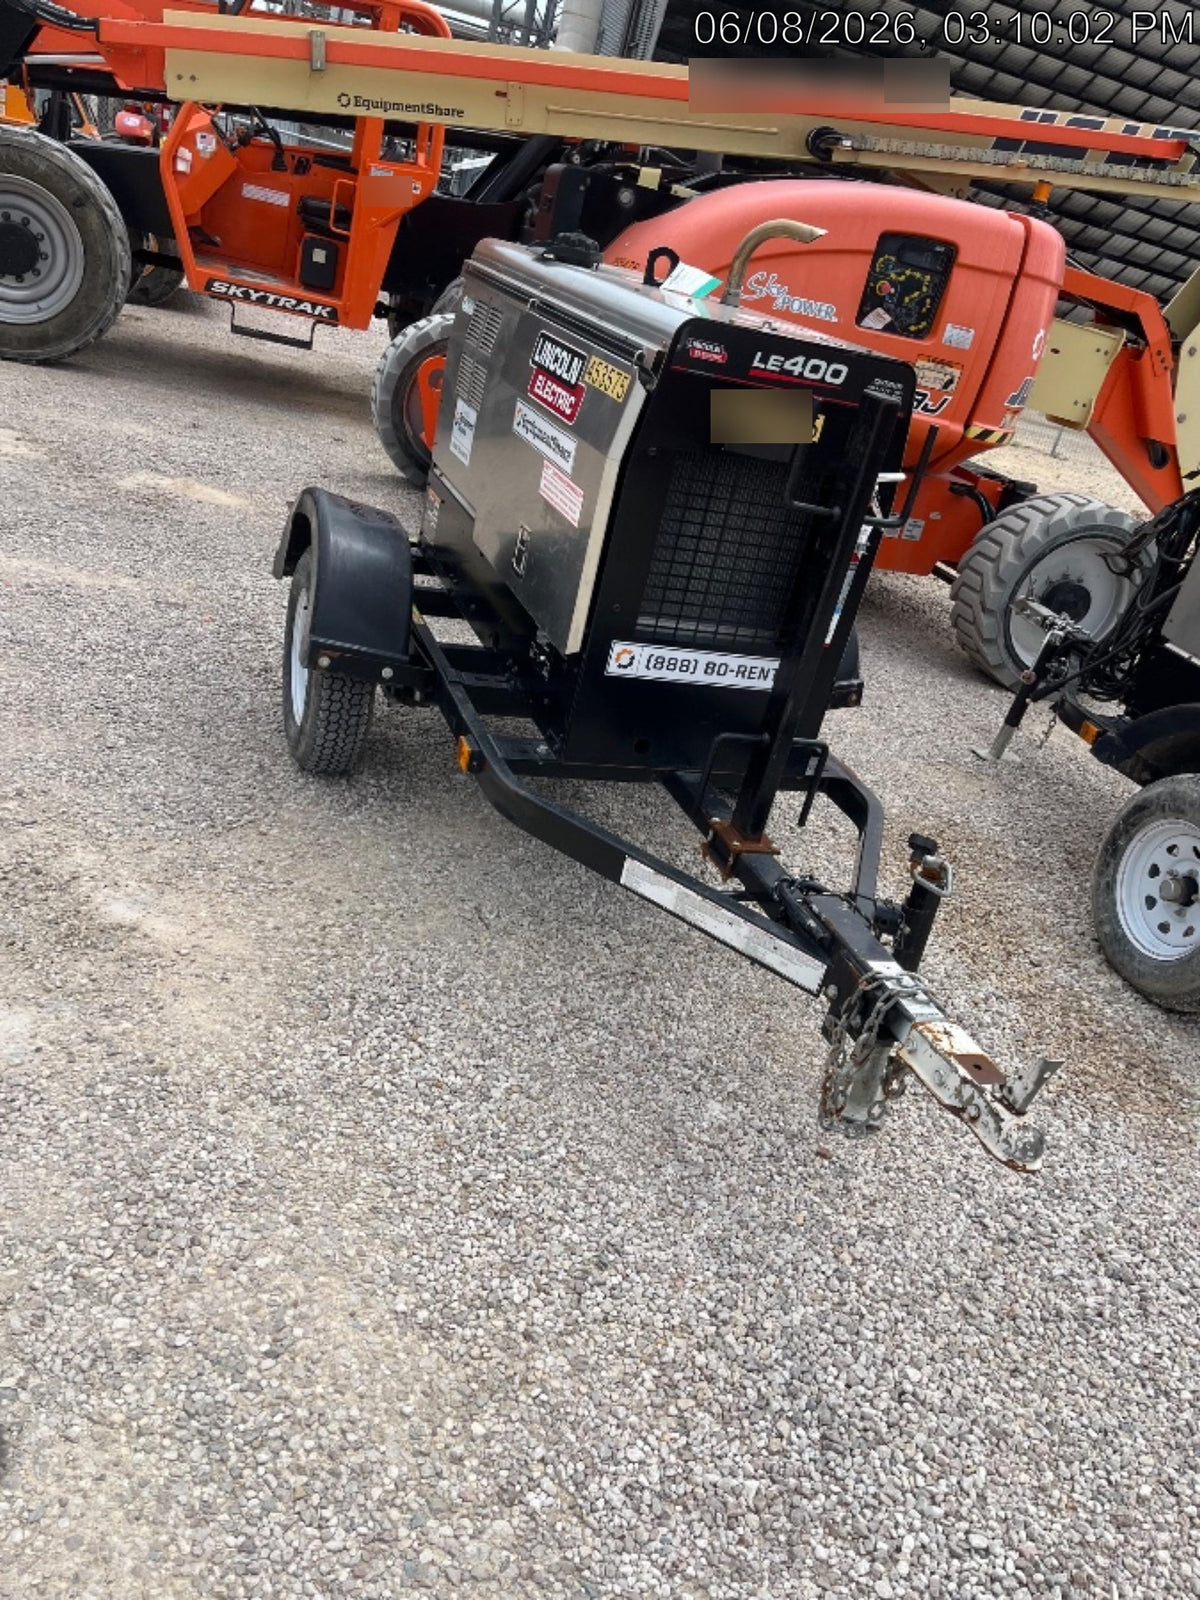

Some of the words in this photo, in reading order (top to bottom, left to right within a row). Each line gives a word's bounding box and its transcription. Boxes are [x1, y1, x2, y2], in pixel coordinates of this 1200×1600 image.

[353, 95, 465, 118] EquipmentShare
[210, 281, 332, 317] SKYTRAK
[740, 271, 789, 310] Sky
[780, 296, 837, 321] POWER
[534, 337, 583, 385] LINCOLN
[751, 351, 849, 385] LE400
[533, 374, 577, 415] ELECTRIC
[585, 359, 631, 400] 453575
[645, 653, 698, 675] (888)
